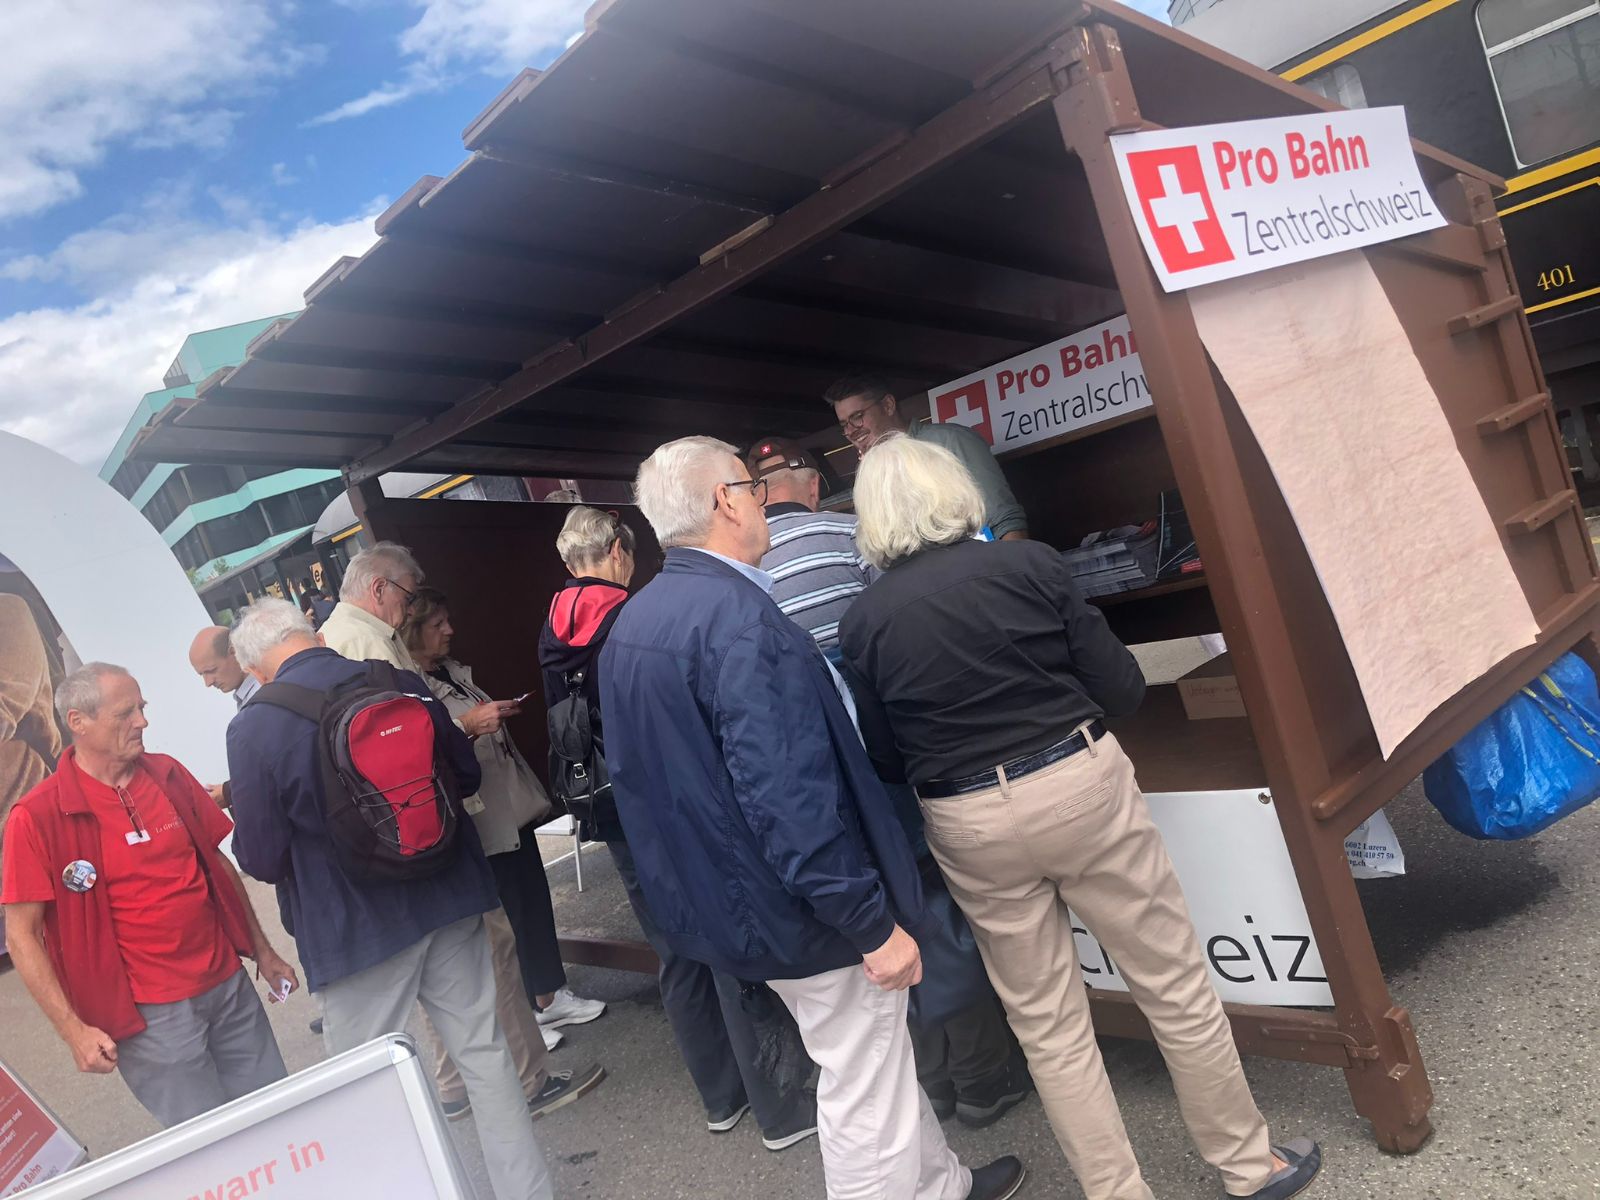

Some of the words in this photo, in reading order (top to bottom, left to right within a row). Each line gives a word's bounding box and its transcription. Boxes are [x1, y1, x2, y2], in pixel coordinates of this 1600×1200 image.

[1212, 141, 1278, 190] Pro
[1285, 124, 1370, 180] Bahn
[1231, 181, 1432, 257] Zentralschweiz
[1537, 264, 1576, 291] 401
[996, 363, 1050, 401] Pro
[1001, 371, 1151, 442] Zentralsch
[1363, 843, 1387, 851] Luzern
[23, 1163, 43, 1184] Bahn
[287, 1140, 325, 1173] in
